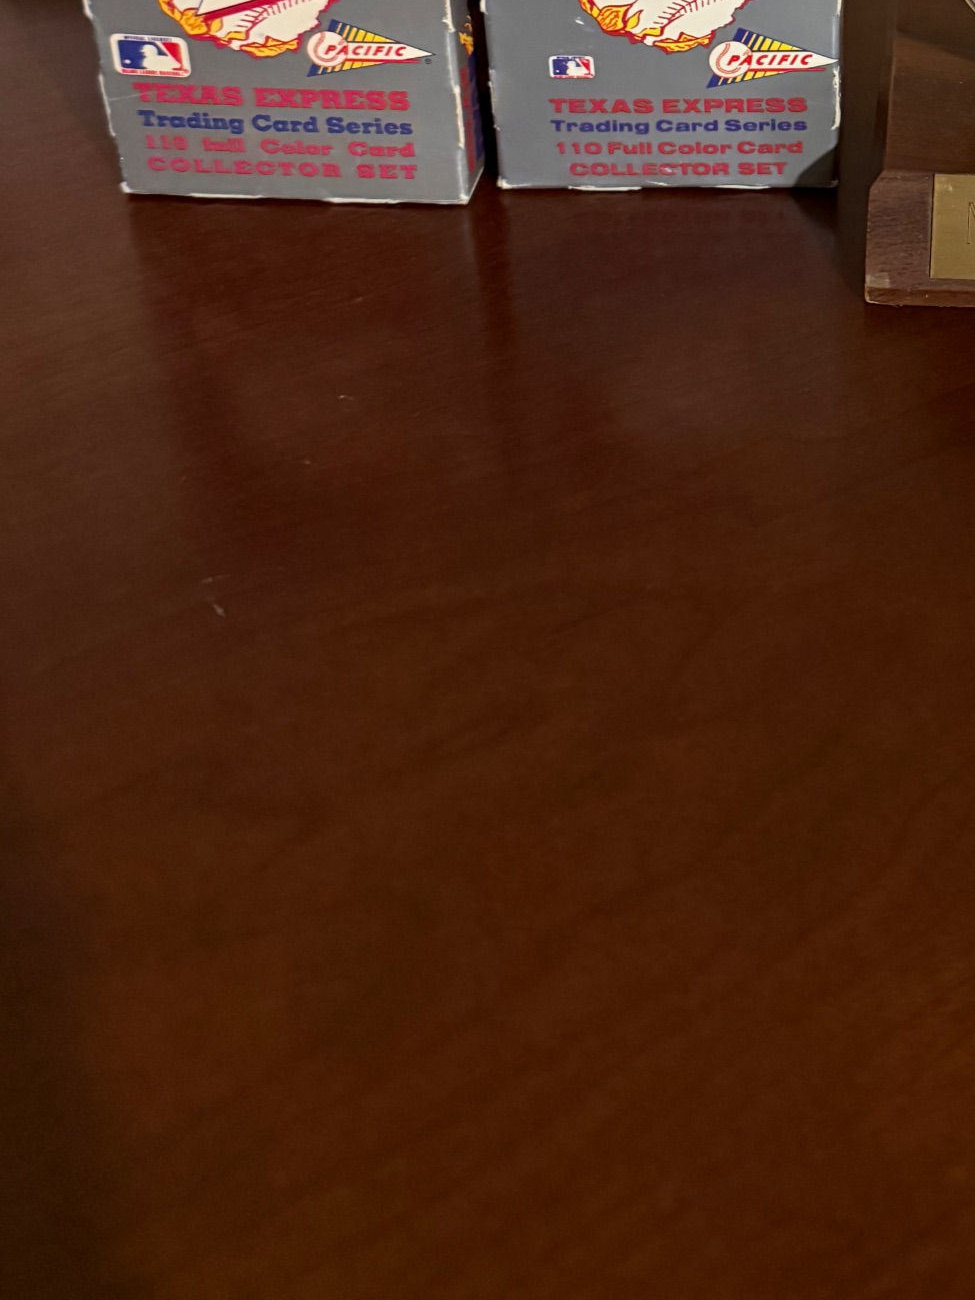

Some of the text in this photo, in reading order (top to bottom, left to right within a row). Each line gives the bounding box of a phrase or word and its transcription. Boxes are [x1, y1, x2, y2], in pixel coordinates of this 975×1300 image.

[324, 43, 408, 58] PACIFIC
[726, 53, 814, 67] PACIFIC
[132, 82, 411, 112] TEXAS EXPRESS
[548, 97, 808, 115] TEXAS EXPRESS
[137, 110, 414, 136] Trading Card Series
[550, 118, 808, 135] Trading Card Series
[145, 134, 189, 151] 110
[259, 138, 333, 156] Color
[347, 140, 416, 158] Card
[556, 140, 804, 156] 110 Full Color Card
[147, 156, 418, 180] COLLECTOR SET
[568, 161, 788, 177] COLLECTOR SET
